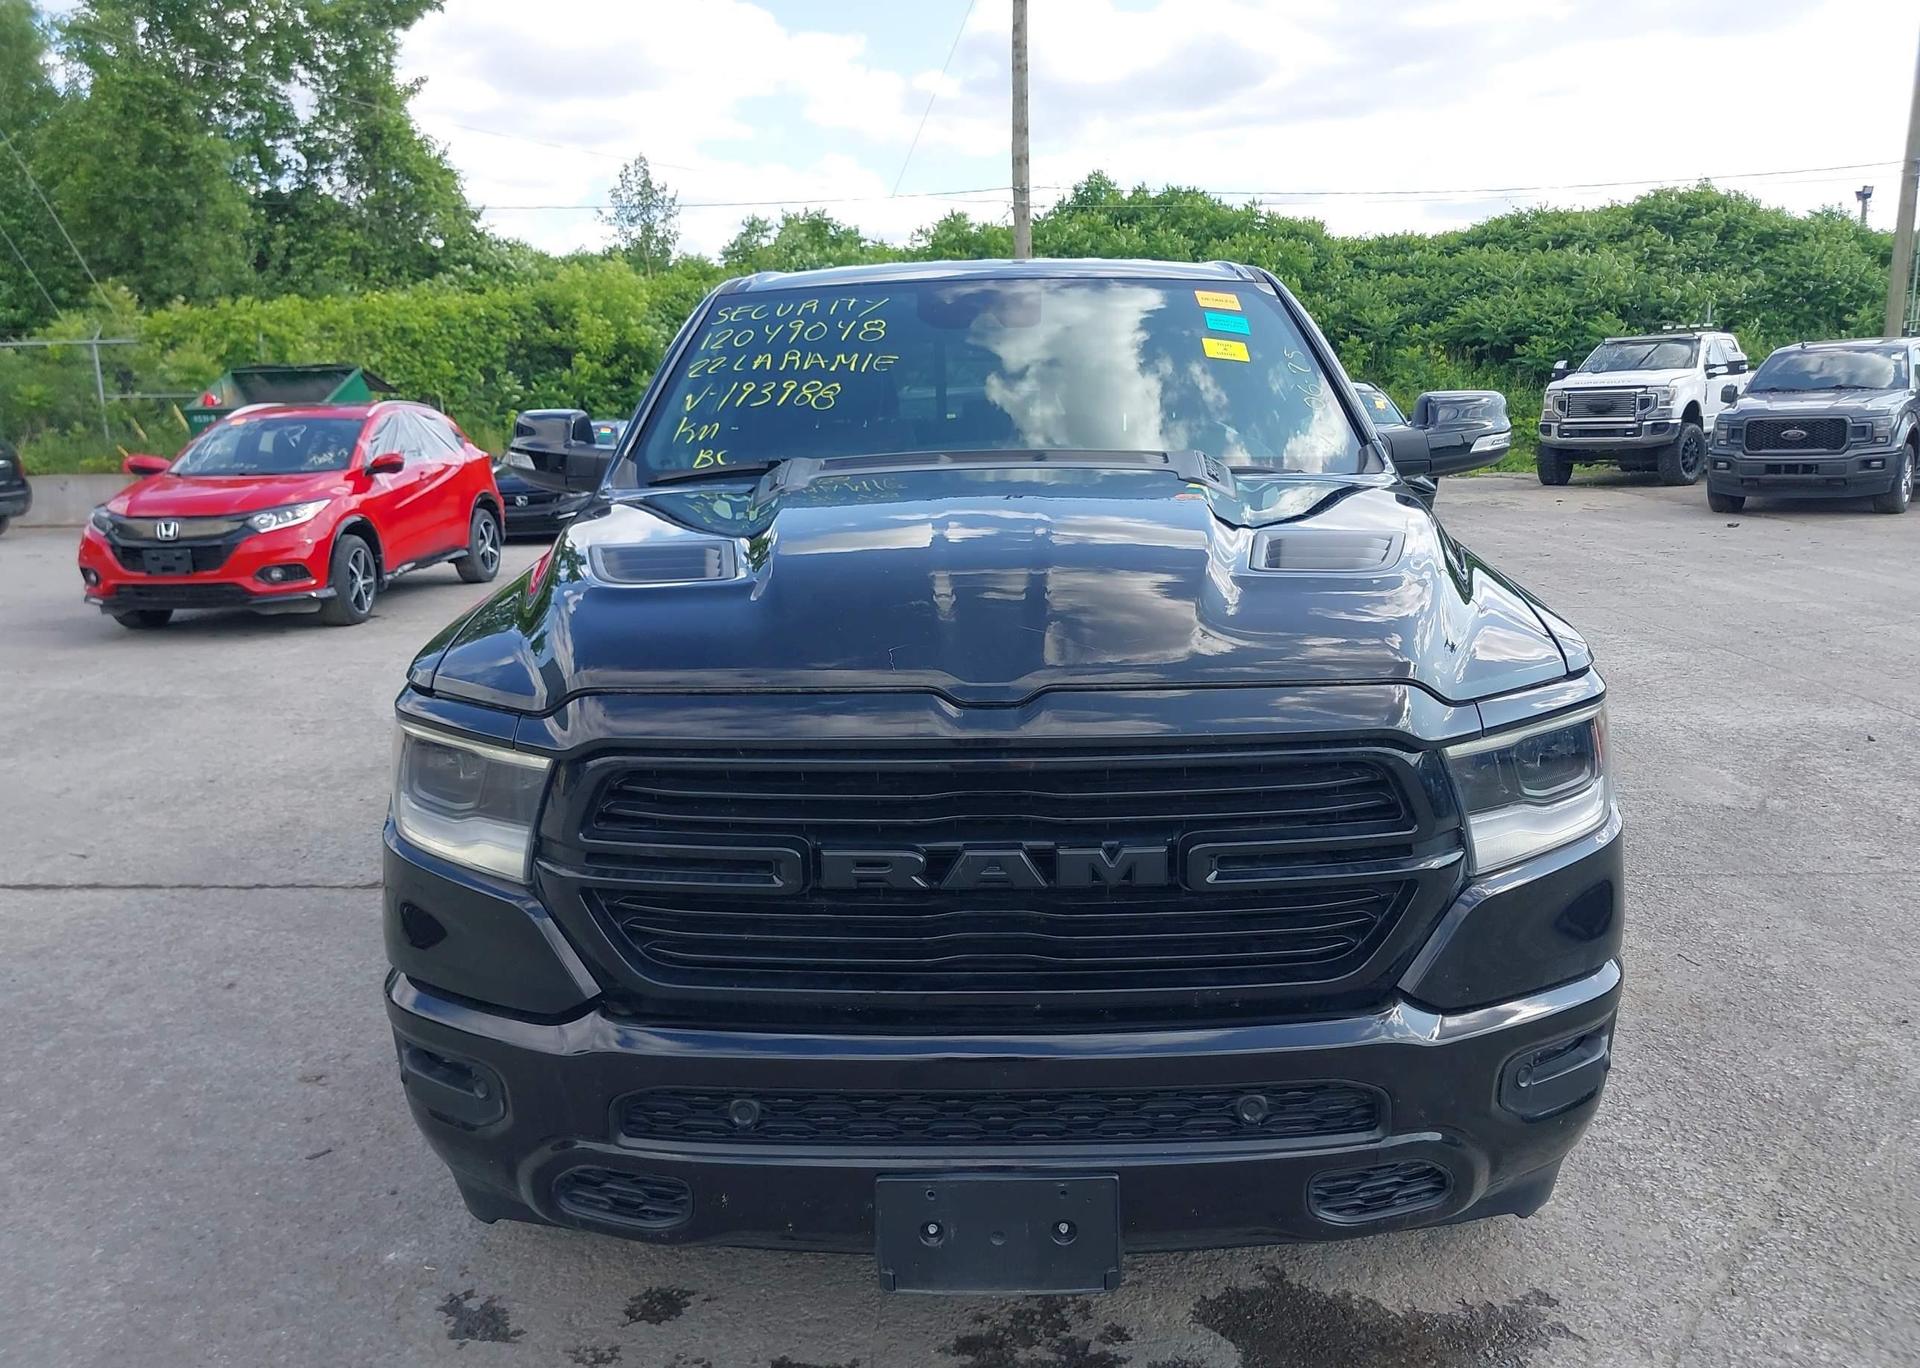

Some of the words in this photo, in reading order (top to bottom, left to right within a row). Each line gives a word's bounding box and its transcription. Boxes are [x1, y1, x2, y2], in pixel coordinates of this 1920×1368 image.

[712, 298, 889, 325] SECURITY
[733, 349, 899, 373] LARAMIE
[821, 847, 1168, 888] RAM
